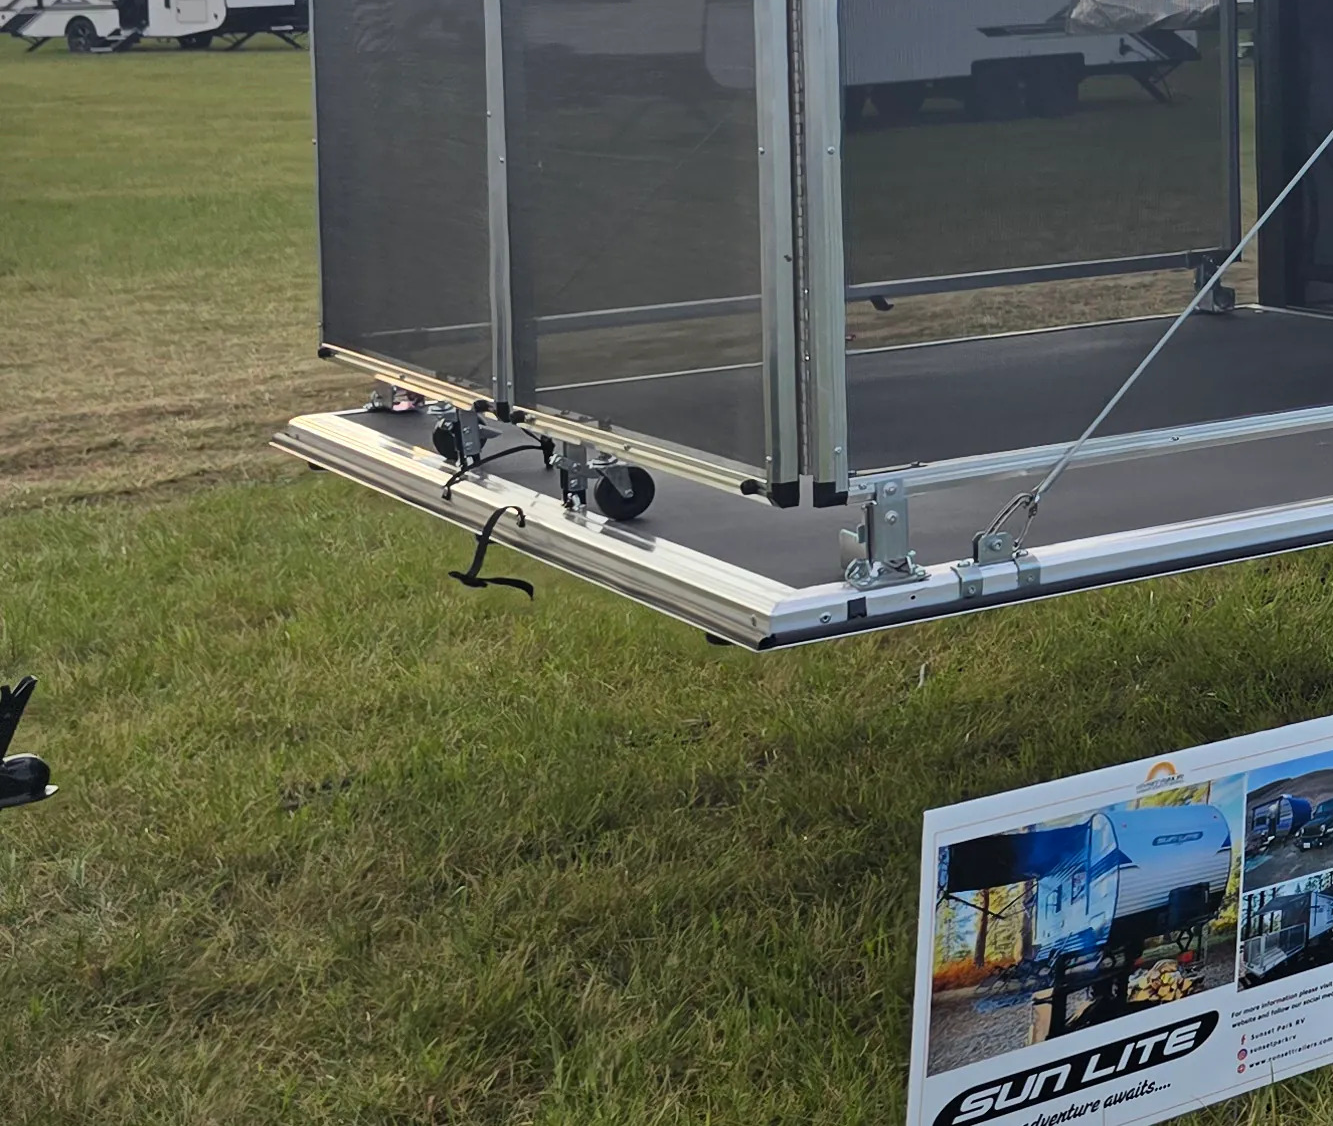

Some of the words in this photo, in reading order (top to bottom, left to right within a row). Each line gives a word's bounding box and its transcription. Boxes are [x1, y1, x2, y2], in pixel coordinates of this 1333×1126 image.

[1231, 1010, 1242, 1018] For
[1243, 1005, 1260, 1014] more
[1261, 993, 1298, 1009] information
[1299, 986, 1318, 998] please
[1320, 981, 1333, 990] visit
[1231, 1016, 1256, 1028] website
[1257, 1011, 1269, 1021] and
[1271, 1006, 1290, 1016] follow
[1291, 1001, 1302, 1010] our
[1303, 995, 1321, 1006] social
[1250, 1028, 1275, 1041] Sunset
[1295, 1017, 1306, 1025] RV
[952, 1063, 1071, 1126] SUN
[1081, 1021, 1202, 1084] LITE
[1023, 1103, 1101, 1126] dventure
